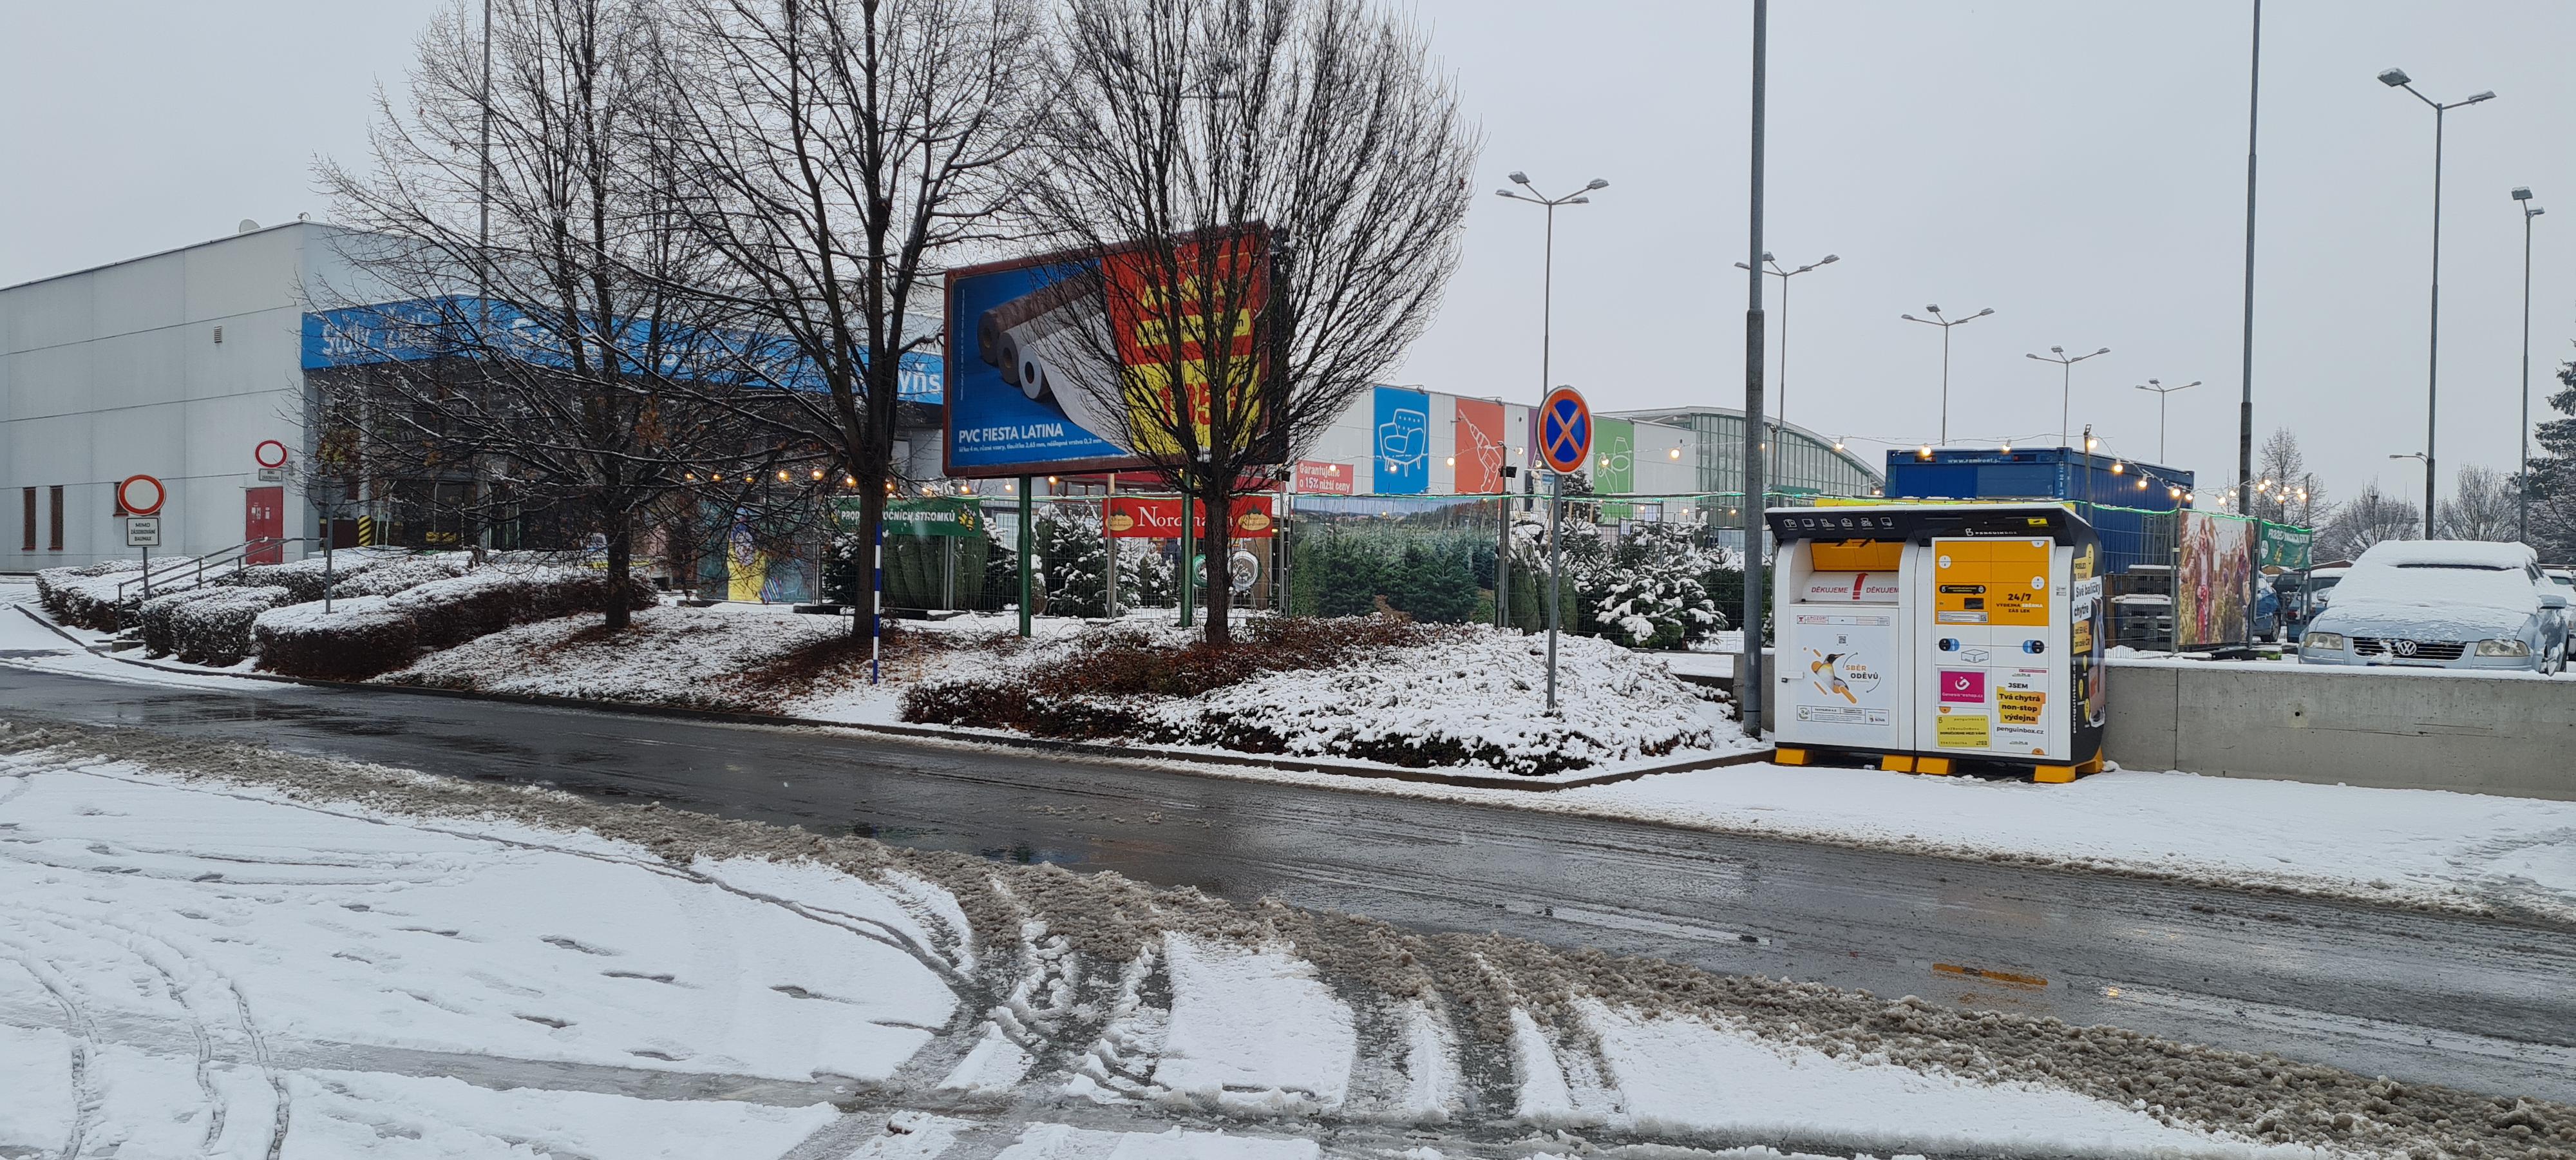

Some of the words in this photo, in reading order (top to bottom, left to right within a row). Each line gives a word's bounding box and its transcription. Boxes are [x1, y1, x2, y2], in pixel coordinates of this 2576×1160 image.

[959, 429, 980, 443] PVC
[983, 426, 1019, 442] FIESTA
[1021, 423, 1064, 439] LATINA
[1300, 479, 1303, 488] o
[1305, 476, 1319, 489] 15%
[1335, 482, 1350, 493] ceny
[916, 509, 955, 522] STROMKŮ
[2008, 593, 2032, 602] 24/7
[2002, 704, 2038, 713] non-stop
[2004, 714, 2036, 722] výdejna
